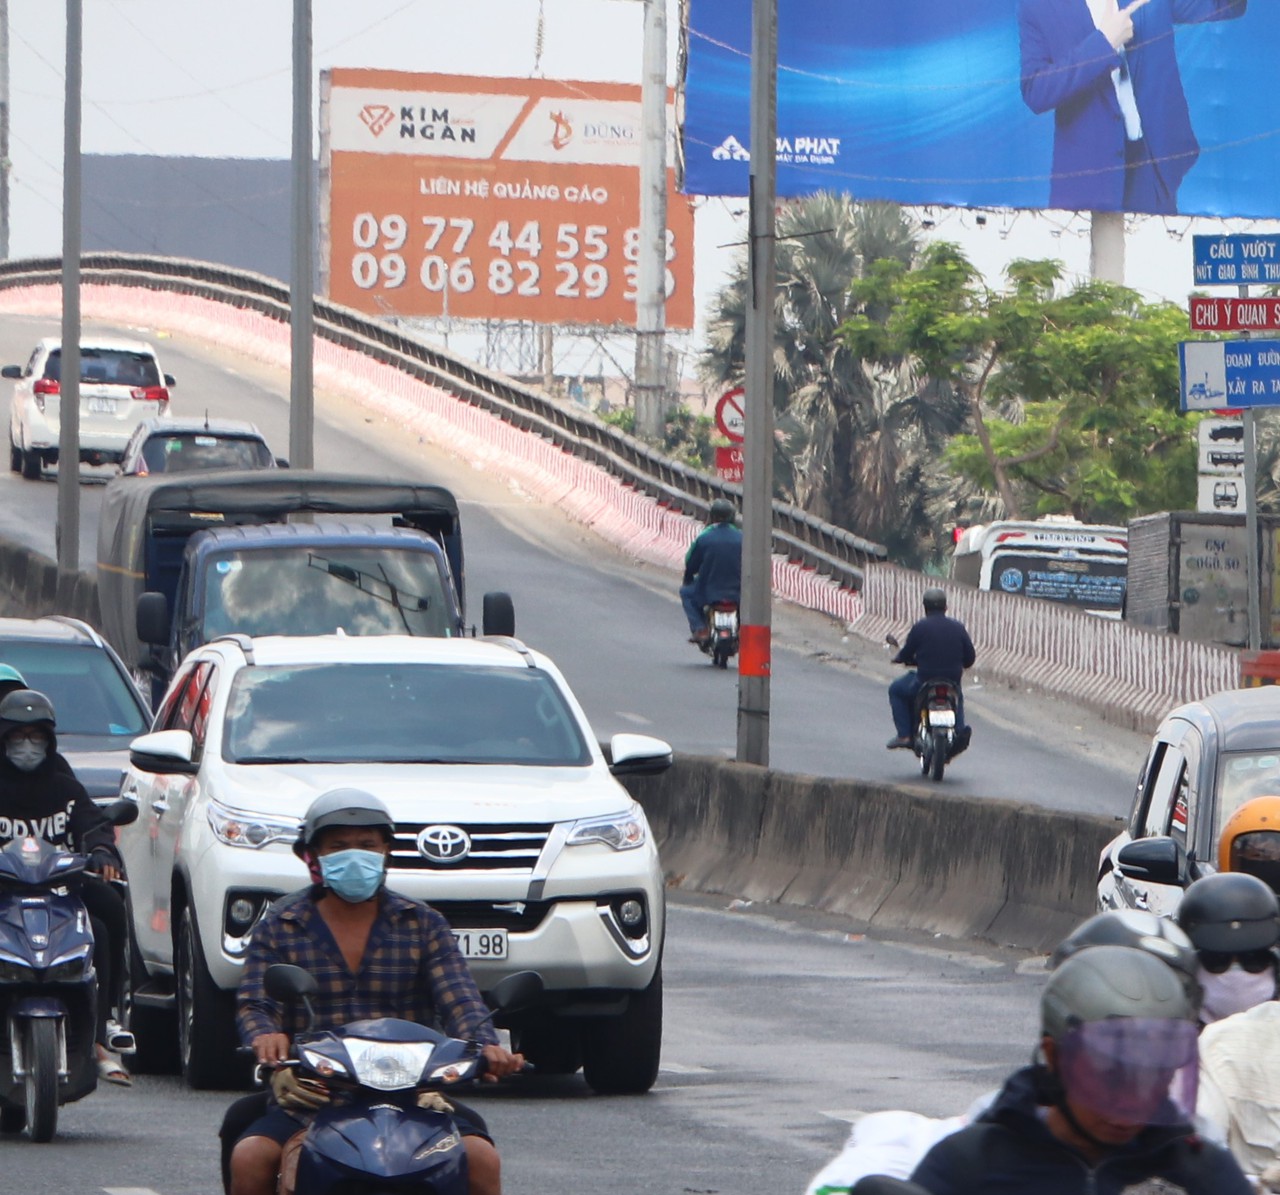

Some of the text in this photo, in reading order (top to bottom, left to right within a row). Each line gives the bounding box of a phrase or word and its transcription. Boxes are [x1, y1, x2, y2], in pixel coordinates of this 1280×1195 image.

[399, 106, 449, 124] KIM
[420, 176, 608, 204] LIÊN HỆ QUẢNG CÁO
[352, 211, 407, 250] 09
[422, 216, 474, 253] 77
[488, 220, 542, 257] 44
[555, 223, 608, 261] 55
[1209, 237, 1276, 262] CẦU VƯỢT
[351, 252, 407, 289] 09
[420, 254, 475, 293] 06
[487, 258, 541, 297] 82
[555, 261, 608, 299] 29
[1196, 260, 1212, 280] NÚT
[1218, 263, 1236, 280] GIAO
[1195, 299, 1218, 326] CHÚ
[1224, 299, 1232, 326] Ý
[1237, 304, 1267, 326] QUAN
[1252, 380, 1266, 395] RA
[452, 933, 504, 956] 71.98
